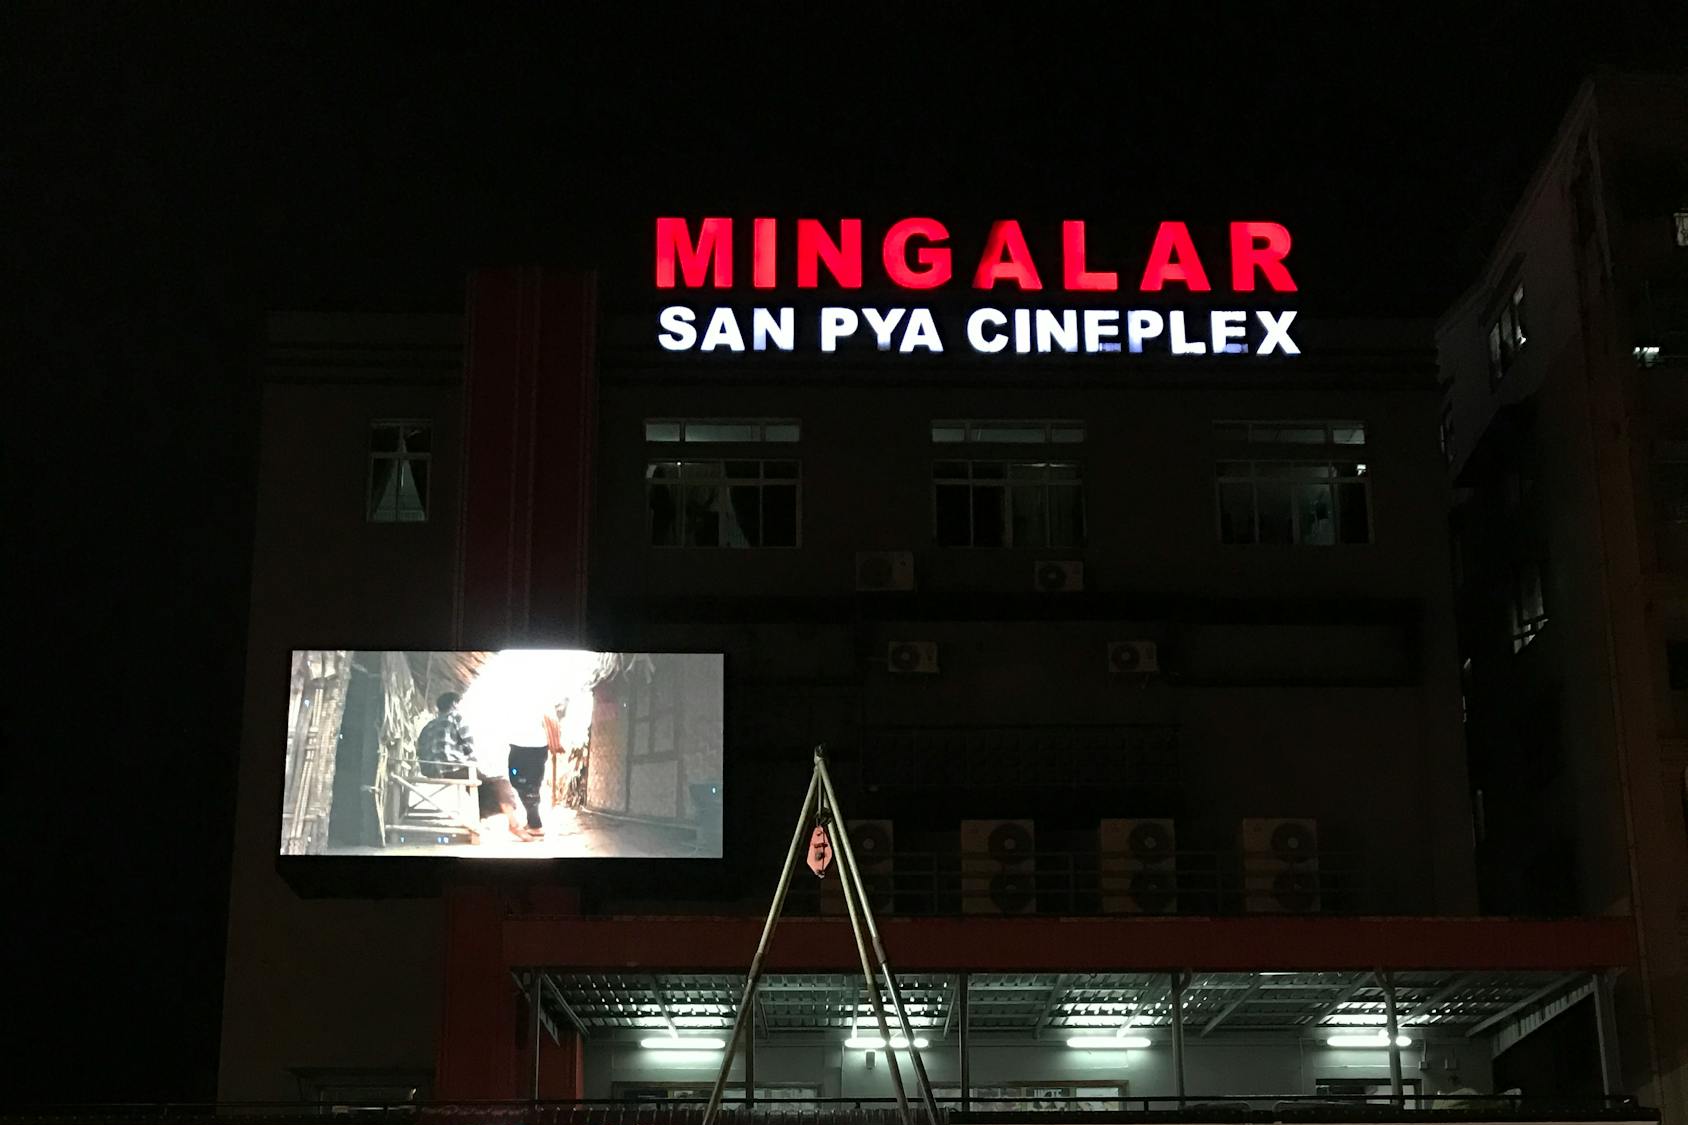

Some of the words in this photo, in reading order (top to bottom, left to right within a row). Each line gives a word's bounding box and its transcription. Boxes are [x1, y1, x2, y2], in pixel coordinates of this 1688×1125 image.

[656, 218, 1298, 291] MINGALAR
[658, 306, 794, 352] SAN
[820, 308, 943, 352] PYA
[967, 309, 1301, 355] CINEPLEX
